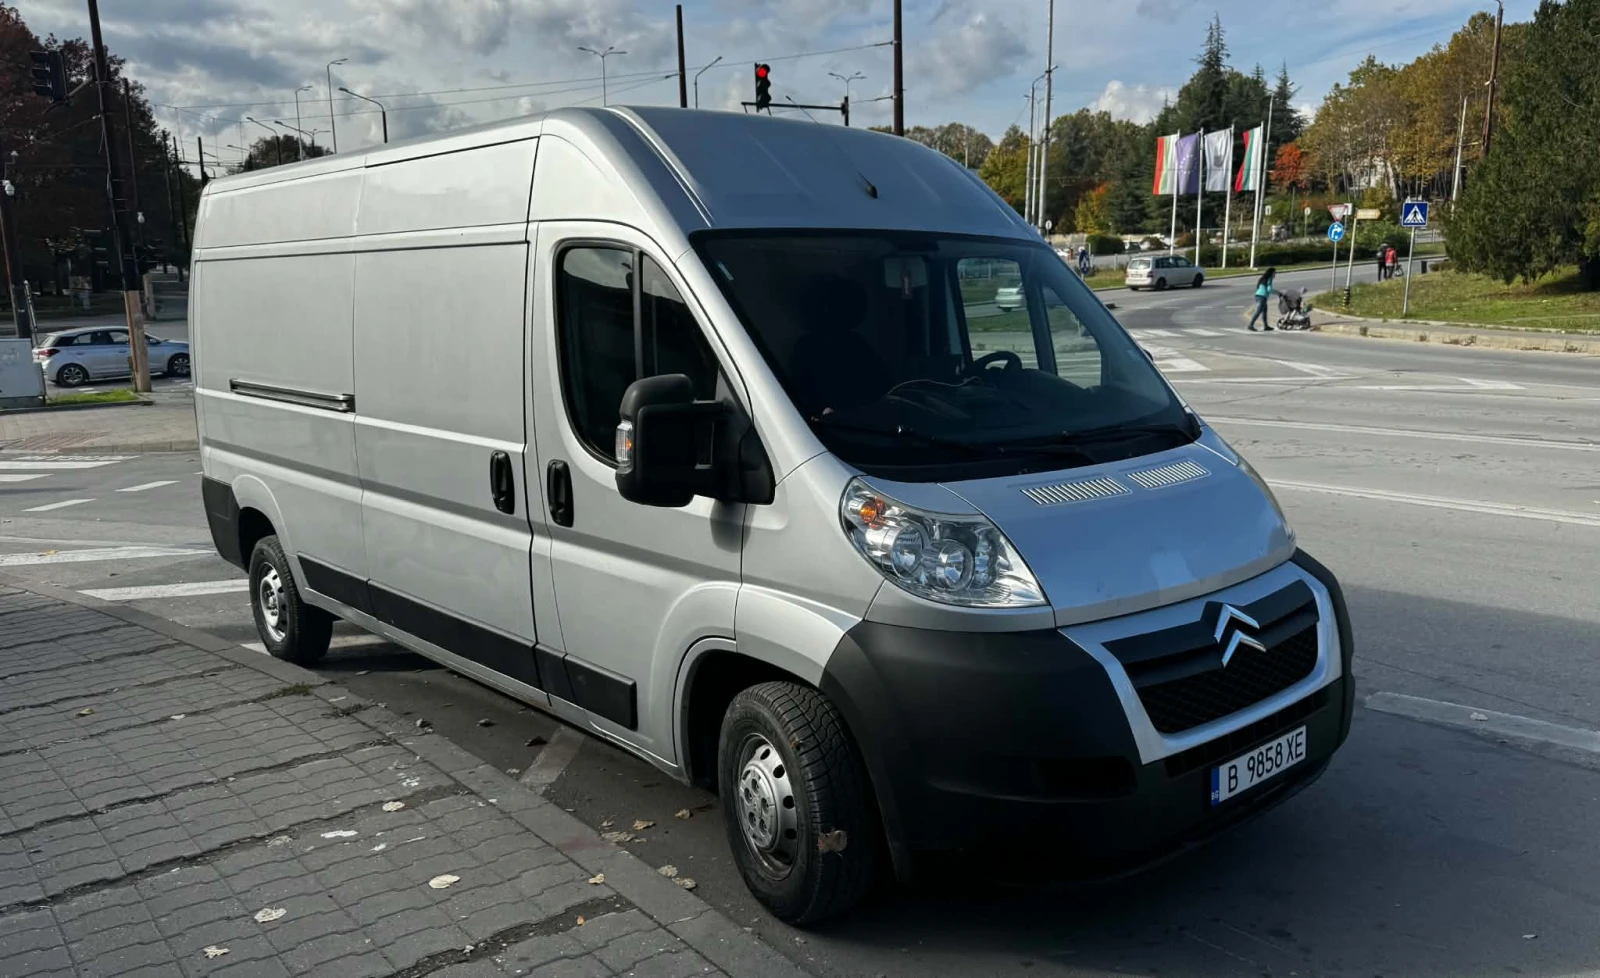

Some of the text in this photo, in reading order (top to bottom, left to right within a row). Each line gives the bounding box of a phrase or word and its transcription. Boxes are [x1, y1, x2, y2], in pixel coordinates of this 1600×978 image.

[1228, 731, 1304, 793] B 9858 XE
